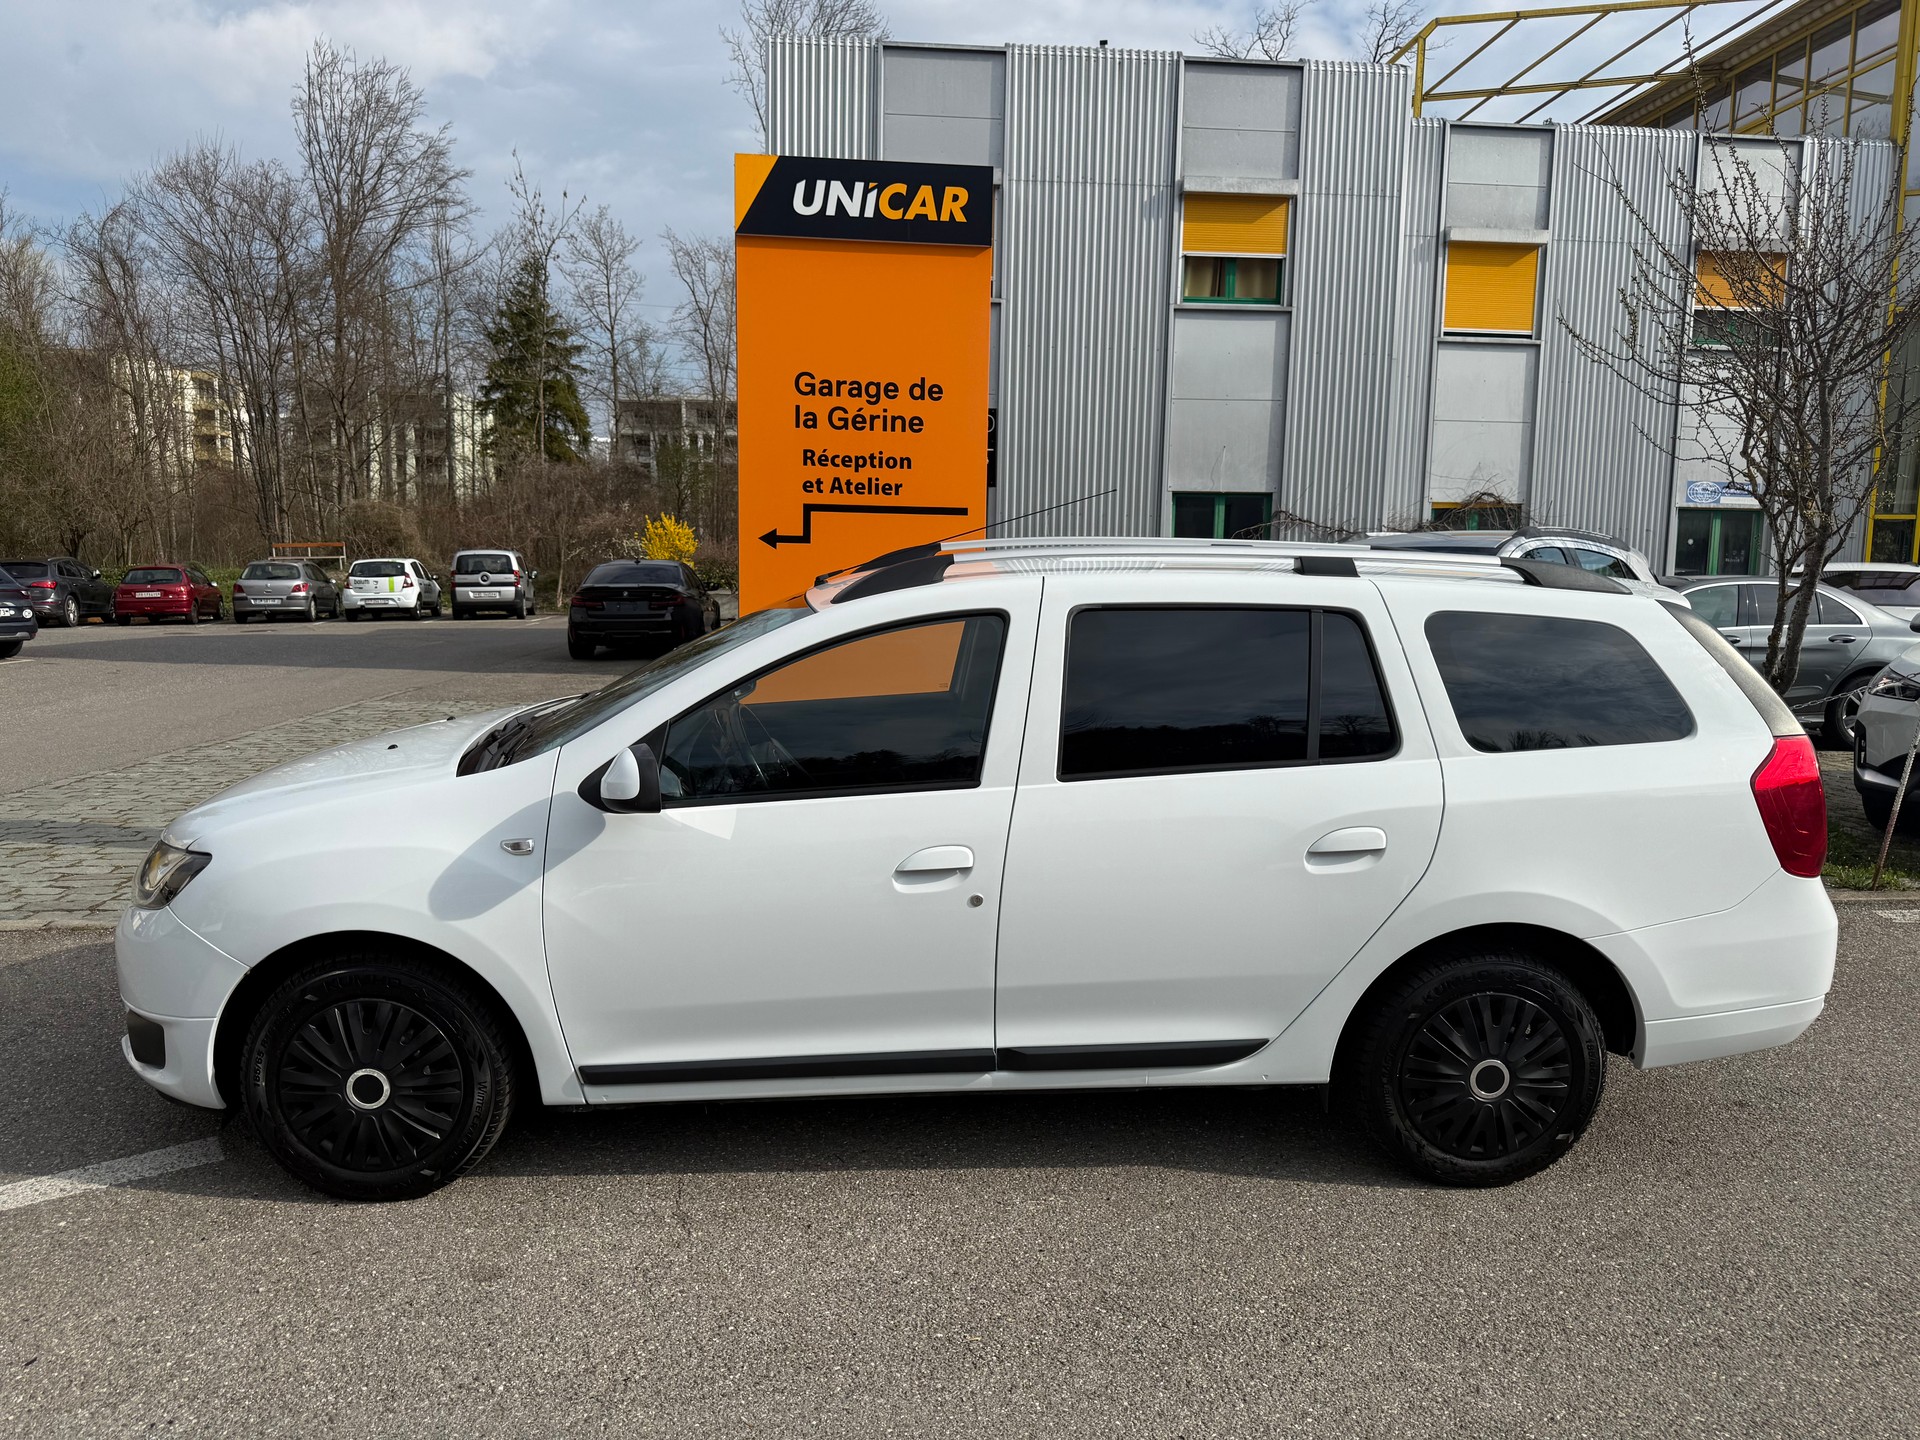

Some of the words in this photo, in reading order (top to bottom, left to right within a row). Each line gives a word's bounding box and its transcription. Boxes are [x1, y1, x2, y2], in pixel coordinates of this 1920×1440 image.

[794, 372, 900, 405] Garage
[908, 377, 944, 402] de
[794, 405, 818, 430] la
[827, 406, 925, 434] Gérine
[802, 449, 912, 473] Réception
[802, 478, 824, 494] et
[829, 477, 903, 496] Atelier
